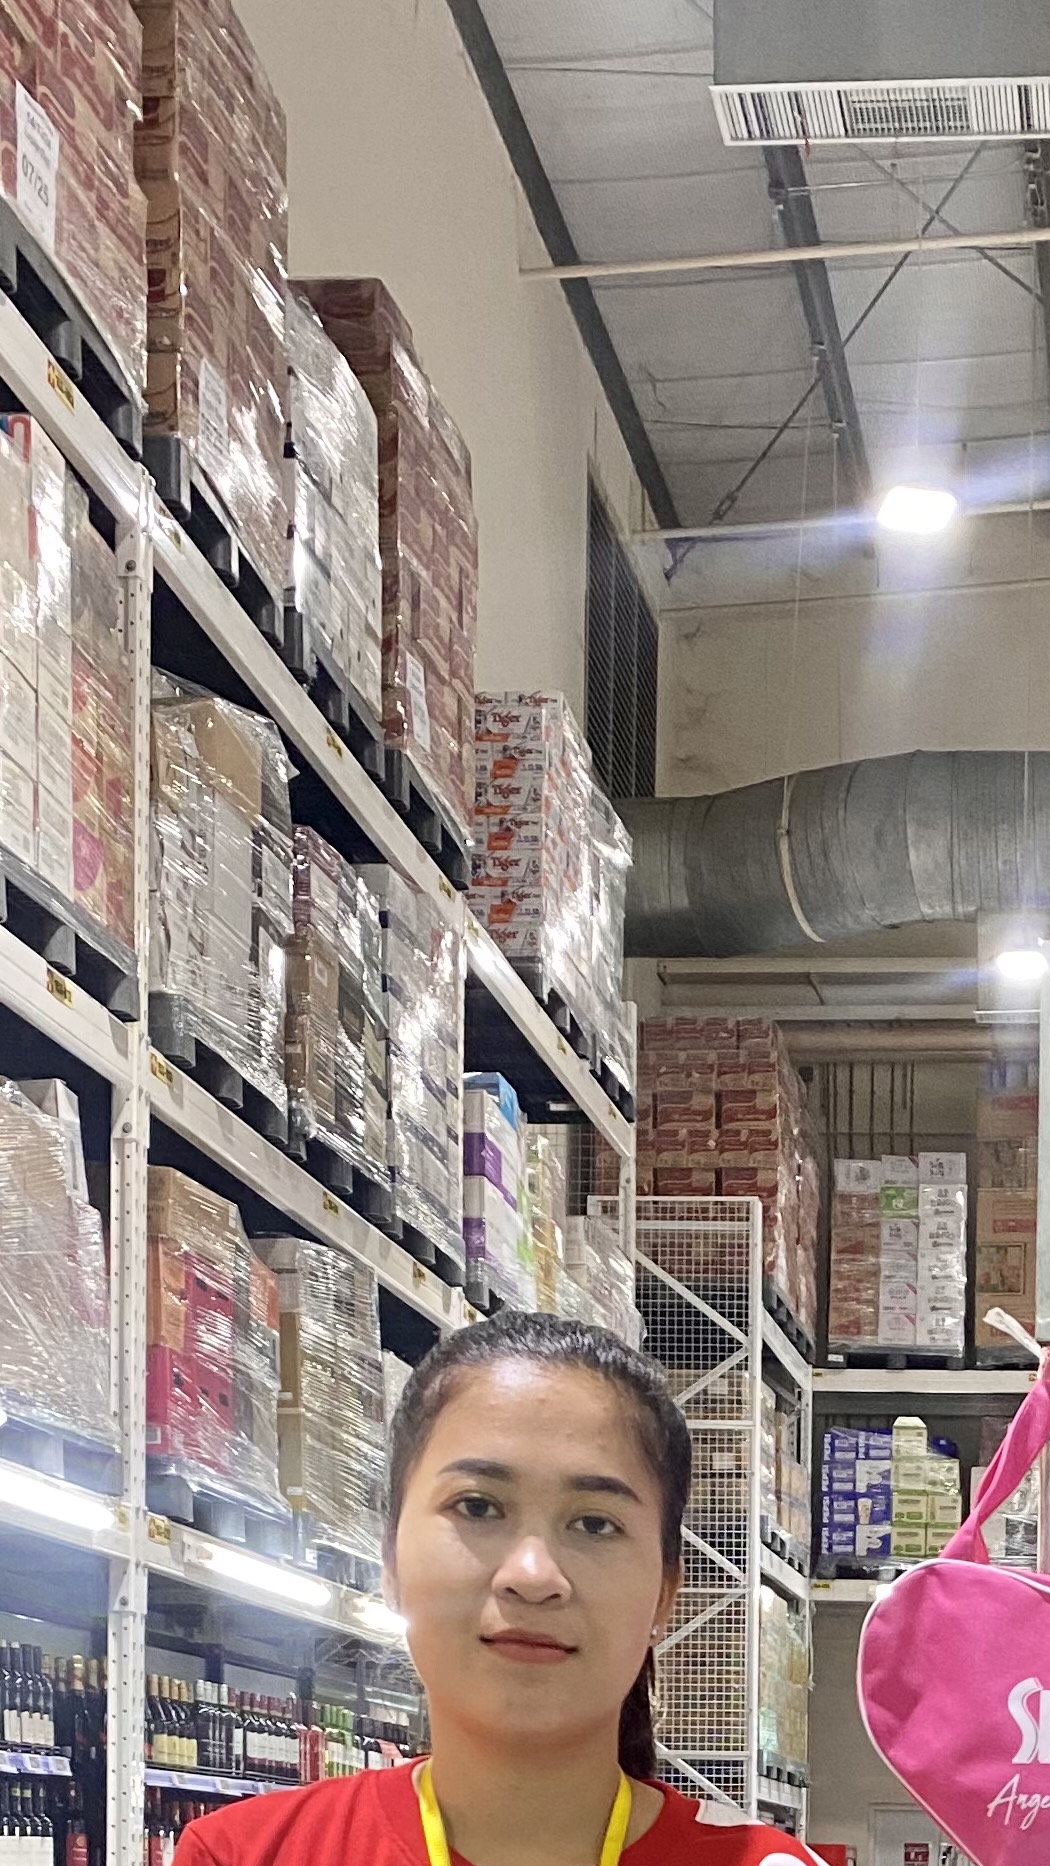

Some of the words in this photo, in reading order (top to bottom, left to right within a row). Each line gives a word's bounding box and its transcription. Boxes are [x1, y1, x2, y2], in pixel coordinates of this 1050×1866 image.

[491, 711, 521, 728] Tiger
[491, 783, 522, 799] Tiger
[490, 856, 521, 871] Tiger
